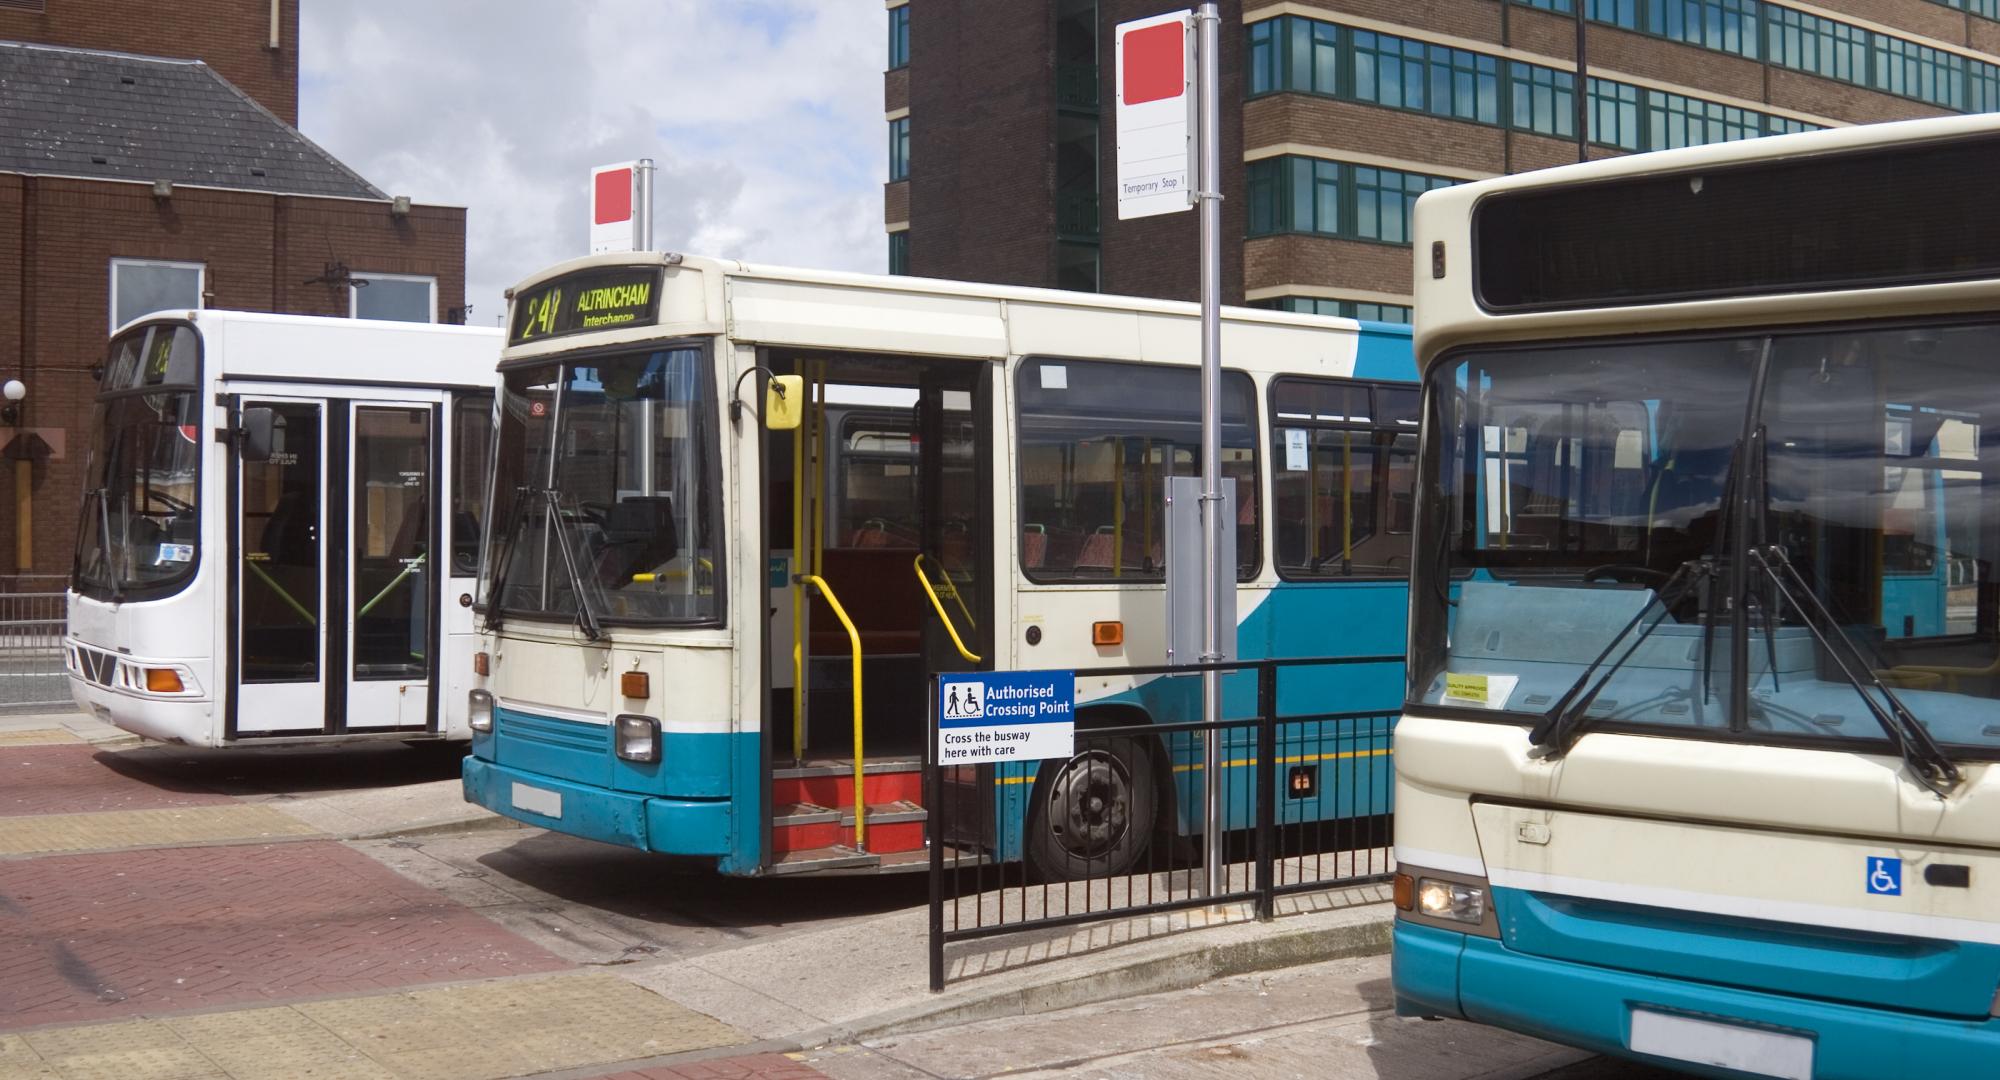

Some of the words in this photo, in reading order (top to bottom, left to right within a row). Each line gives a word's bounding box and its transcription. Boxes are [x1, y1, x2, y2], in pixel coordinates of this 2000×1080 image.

[1124, 182, 1158, 194] Temporary
[1162, 178, 1177, 189] Stop
[577, 283, 650, 312] ALTRINCHAM
[584, 313, 635, 328] Interchange
[986, 684, 1054, 700] Authorised
[986, 702, 1036, 717] Crossing
[1040, 701, 1070, 714] Point
[945, 734, 972, 744] Cross
[975, 732, 991, 742] the
[994, 730, 1030, 742] busway
[944, 748, 967, 758] here
[970, 746, 992, 756] with
[994, 746, 1016, 754] care
